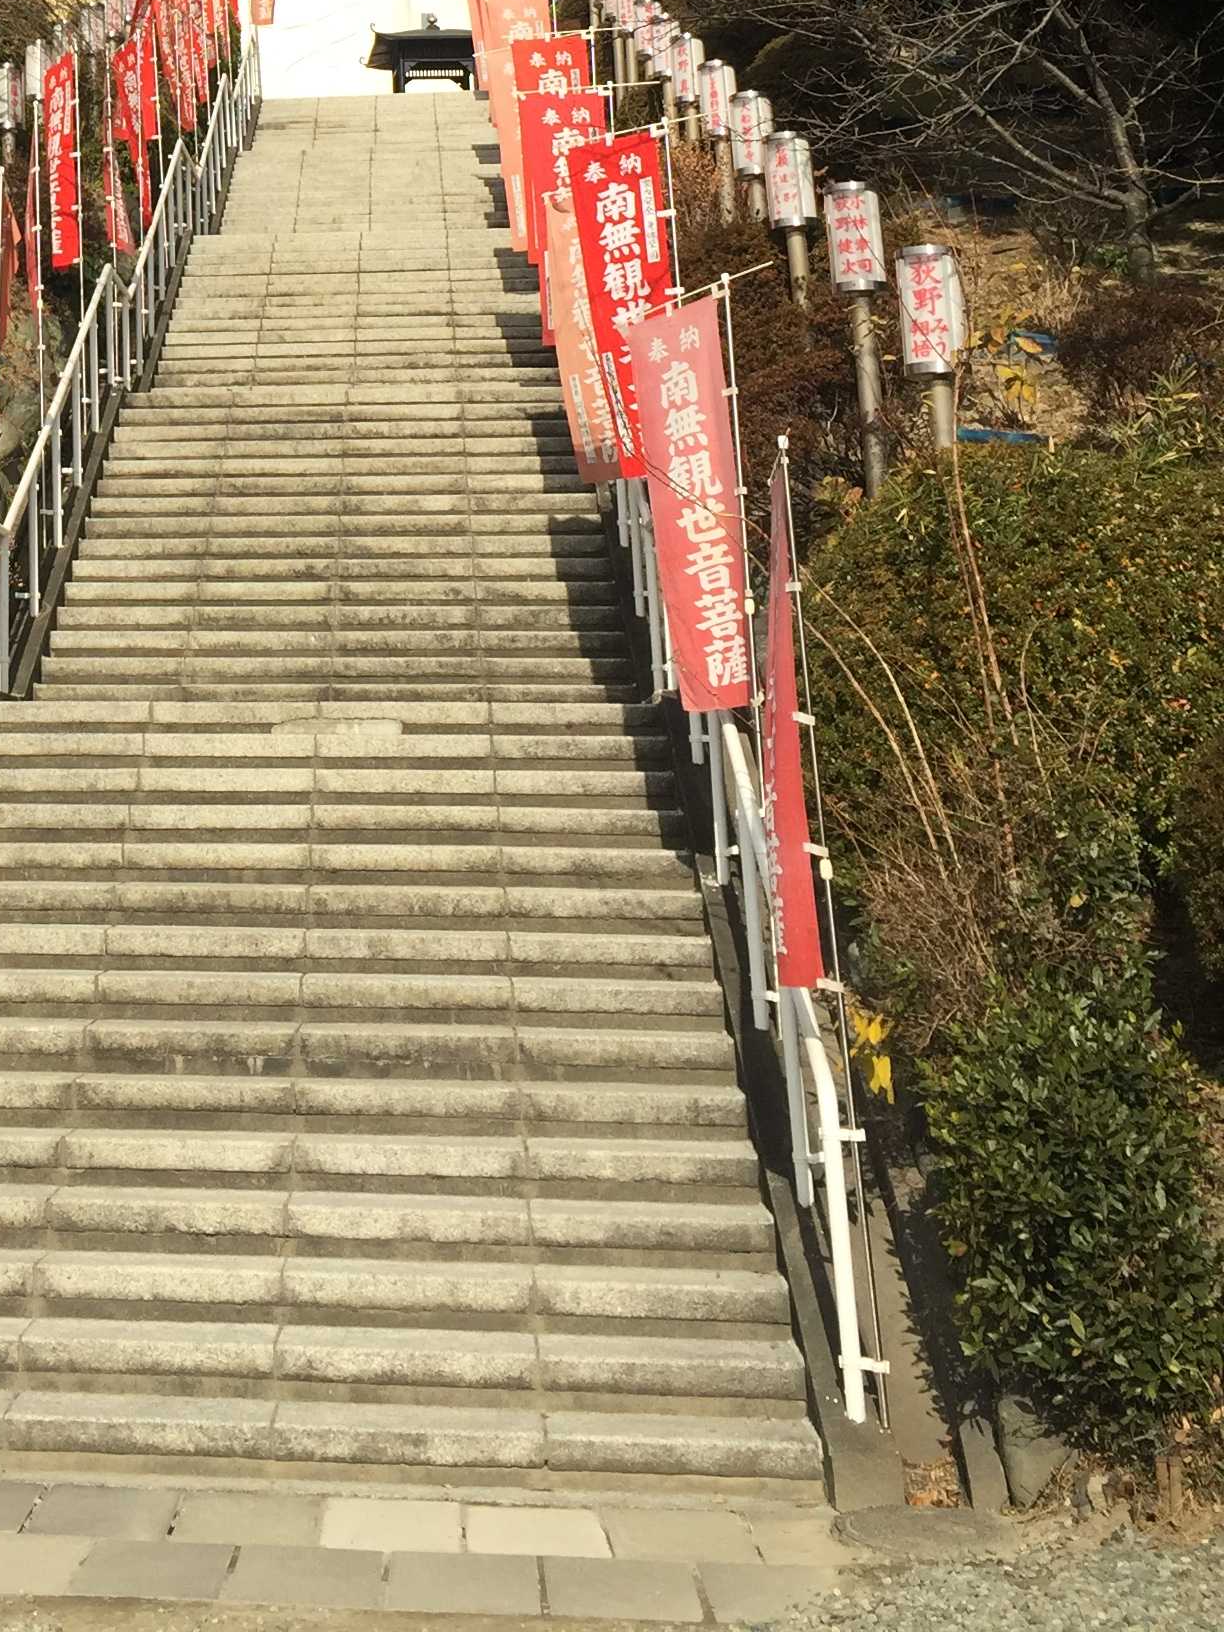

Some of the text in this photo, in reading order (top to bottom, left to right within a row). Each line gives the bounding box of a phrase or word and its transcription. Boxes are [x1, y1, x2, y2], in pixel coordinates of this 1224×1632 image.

[530, 51, 573, 68] 奉納
[541, 107, 591, 126] 奉納
[584, 153, 642, 184] 奉納
[647, 325, 701, 363] 奉納
[659, 360, 750, 687] 南無観世音菩薩
